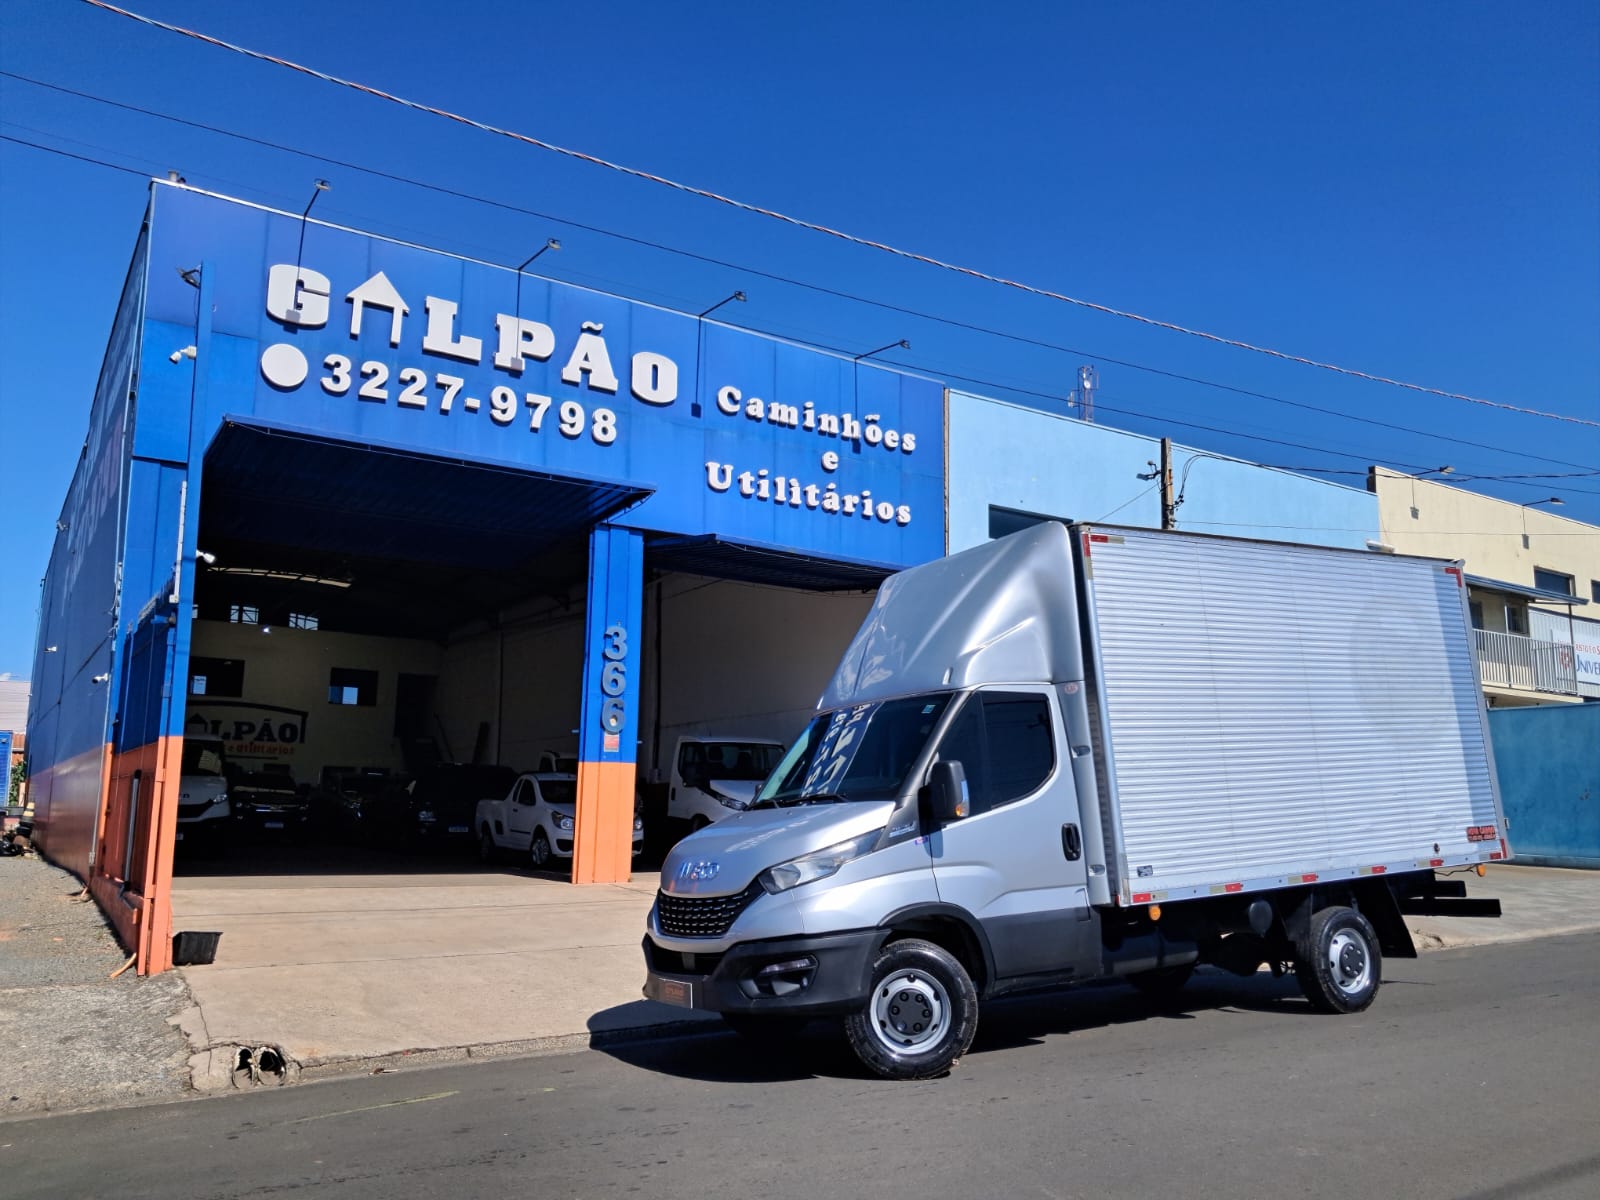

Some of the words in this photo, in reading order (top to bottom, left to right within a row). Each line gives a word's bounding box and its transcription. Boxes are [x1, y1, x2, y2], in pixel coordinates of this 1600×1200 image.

[319, 353, 618, 444] 3227-9798
[716, 385, 917, 453] Caminhões
[705, 461, 912, 525] Utilitários
[821, 450, 840, 471] e
[601, 625, 629, 736] 366
